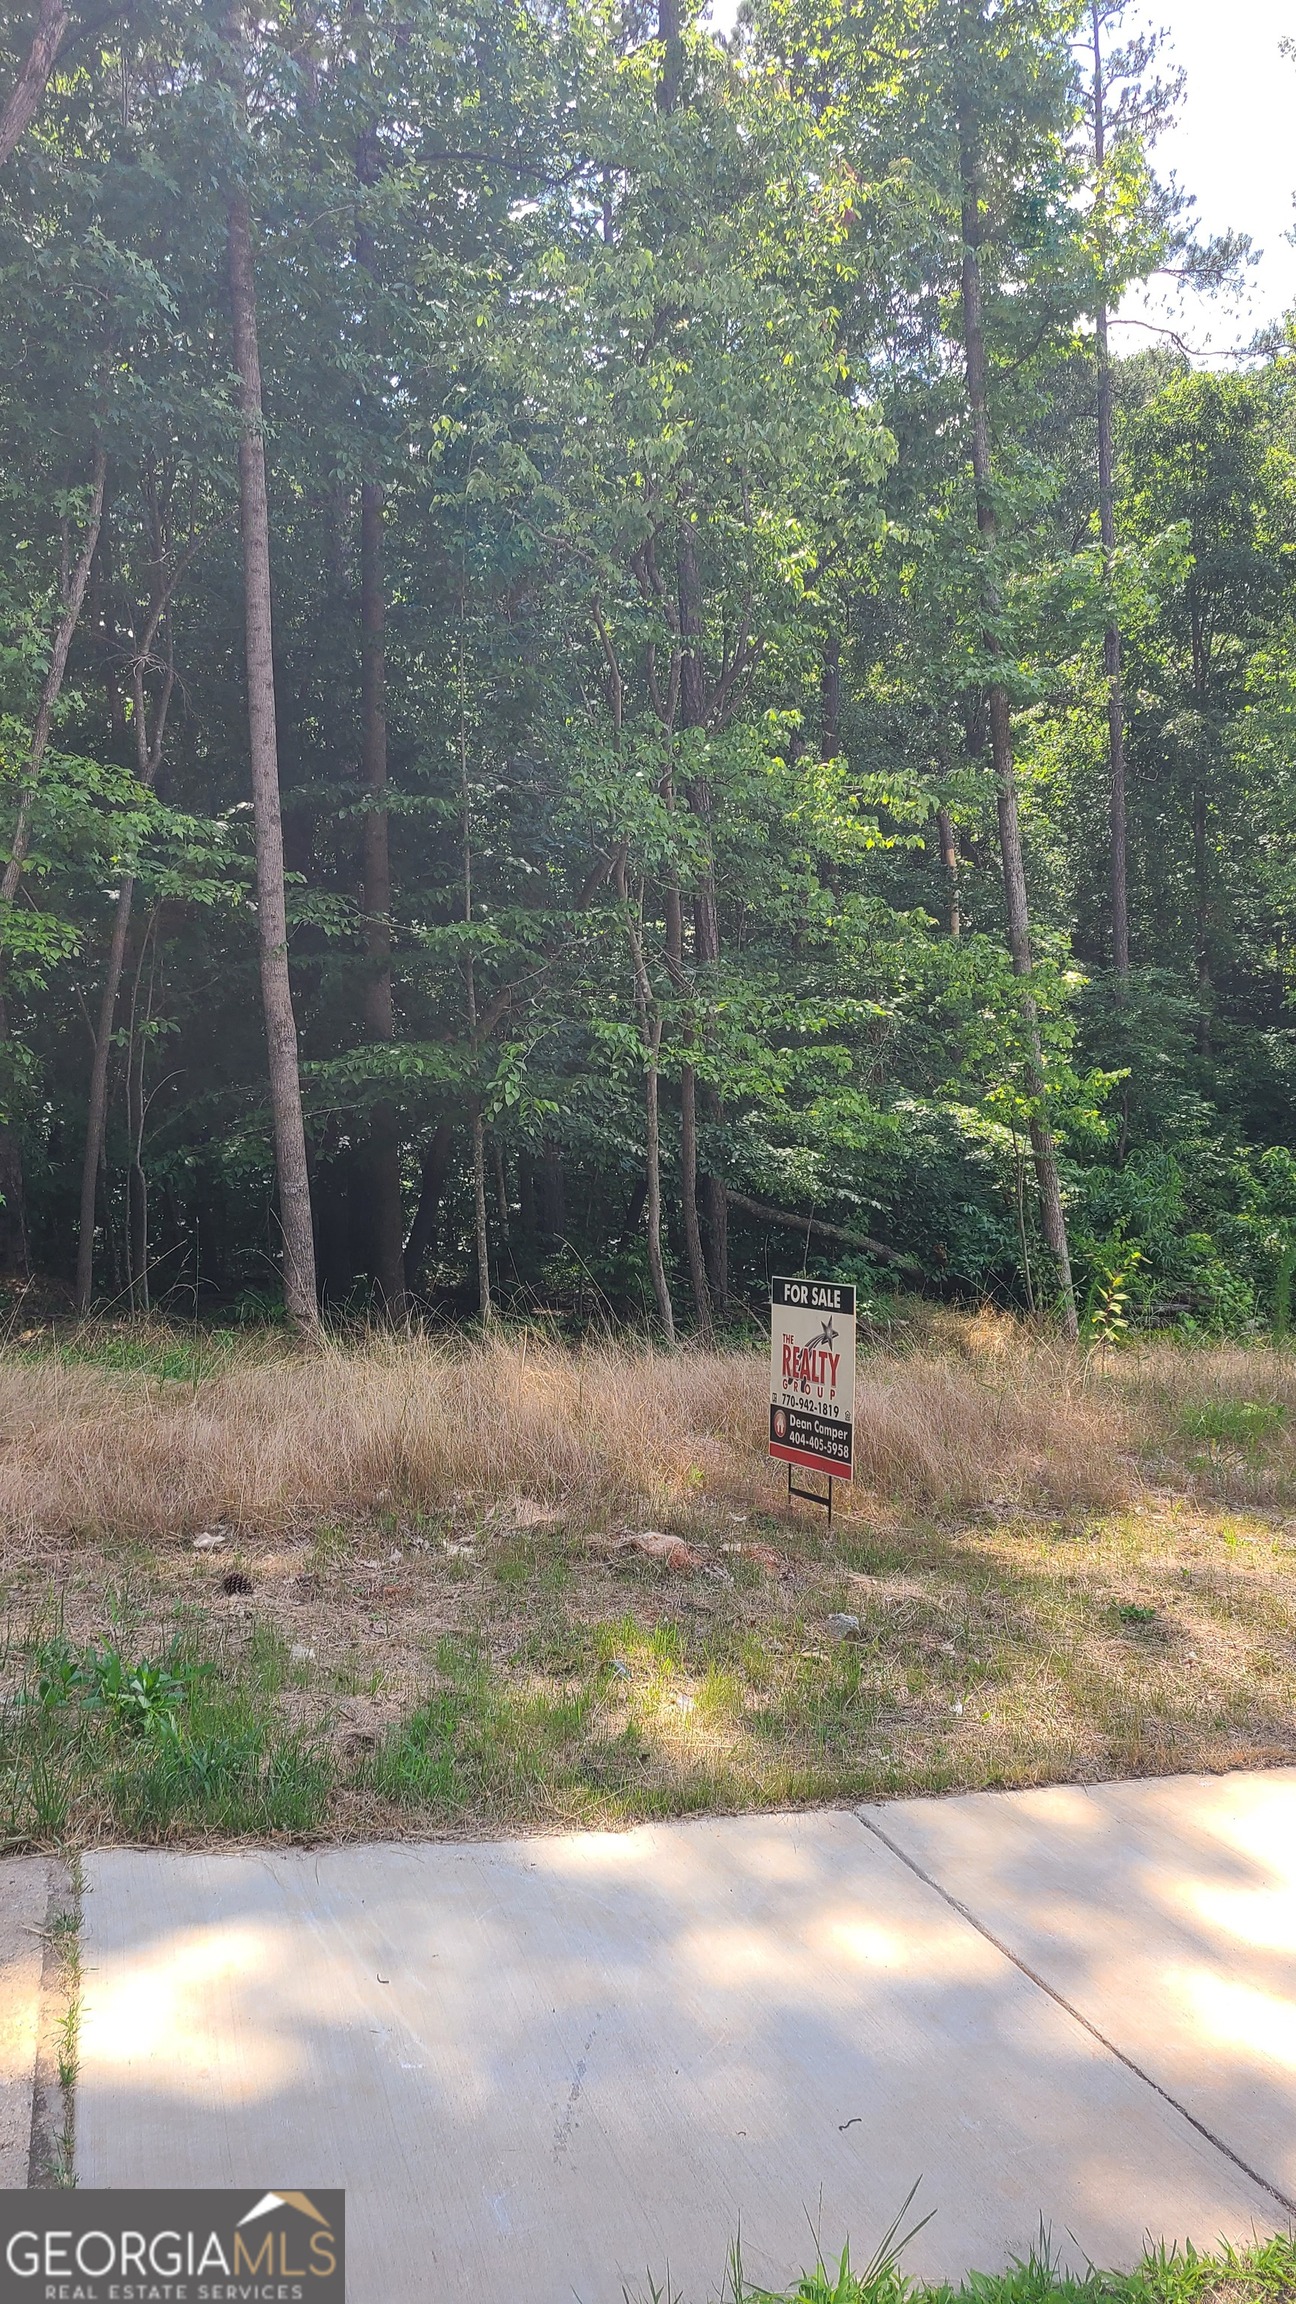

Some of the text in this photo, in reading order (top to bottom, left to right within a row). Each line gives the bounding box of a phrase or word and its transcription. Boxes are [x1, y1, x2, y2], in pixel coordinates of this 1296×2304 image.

[784, 1283, 841, 1309] FOR SALE
[782, 1333, 794, 1345] THE
[782, 1344, 841, 1387] REALTY
[782, 1379, 836, 1400] GROUP
[782, 1393, 840, 1418] 770-942-1819
[789, 1413, 848, 1441] Dean Camper
[789, 1431, 849, 1459] 404-405-5958
